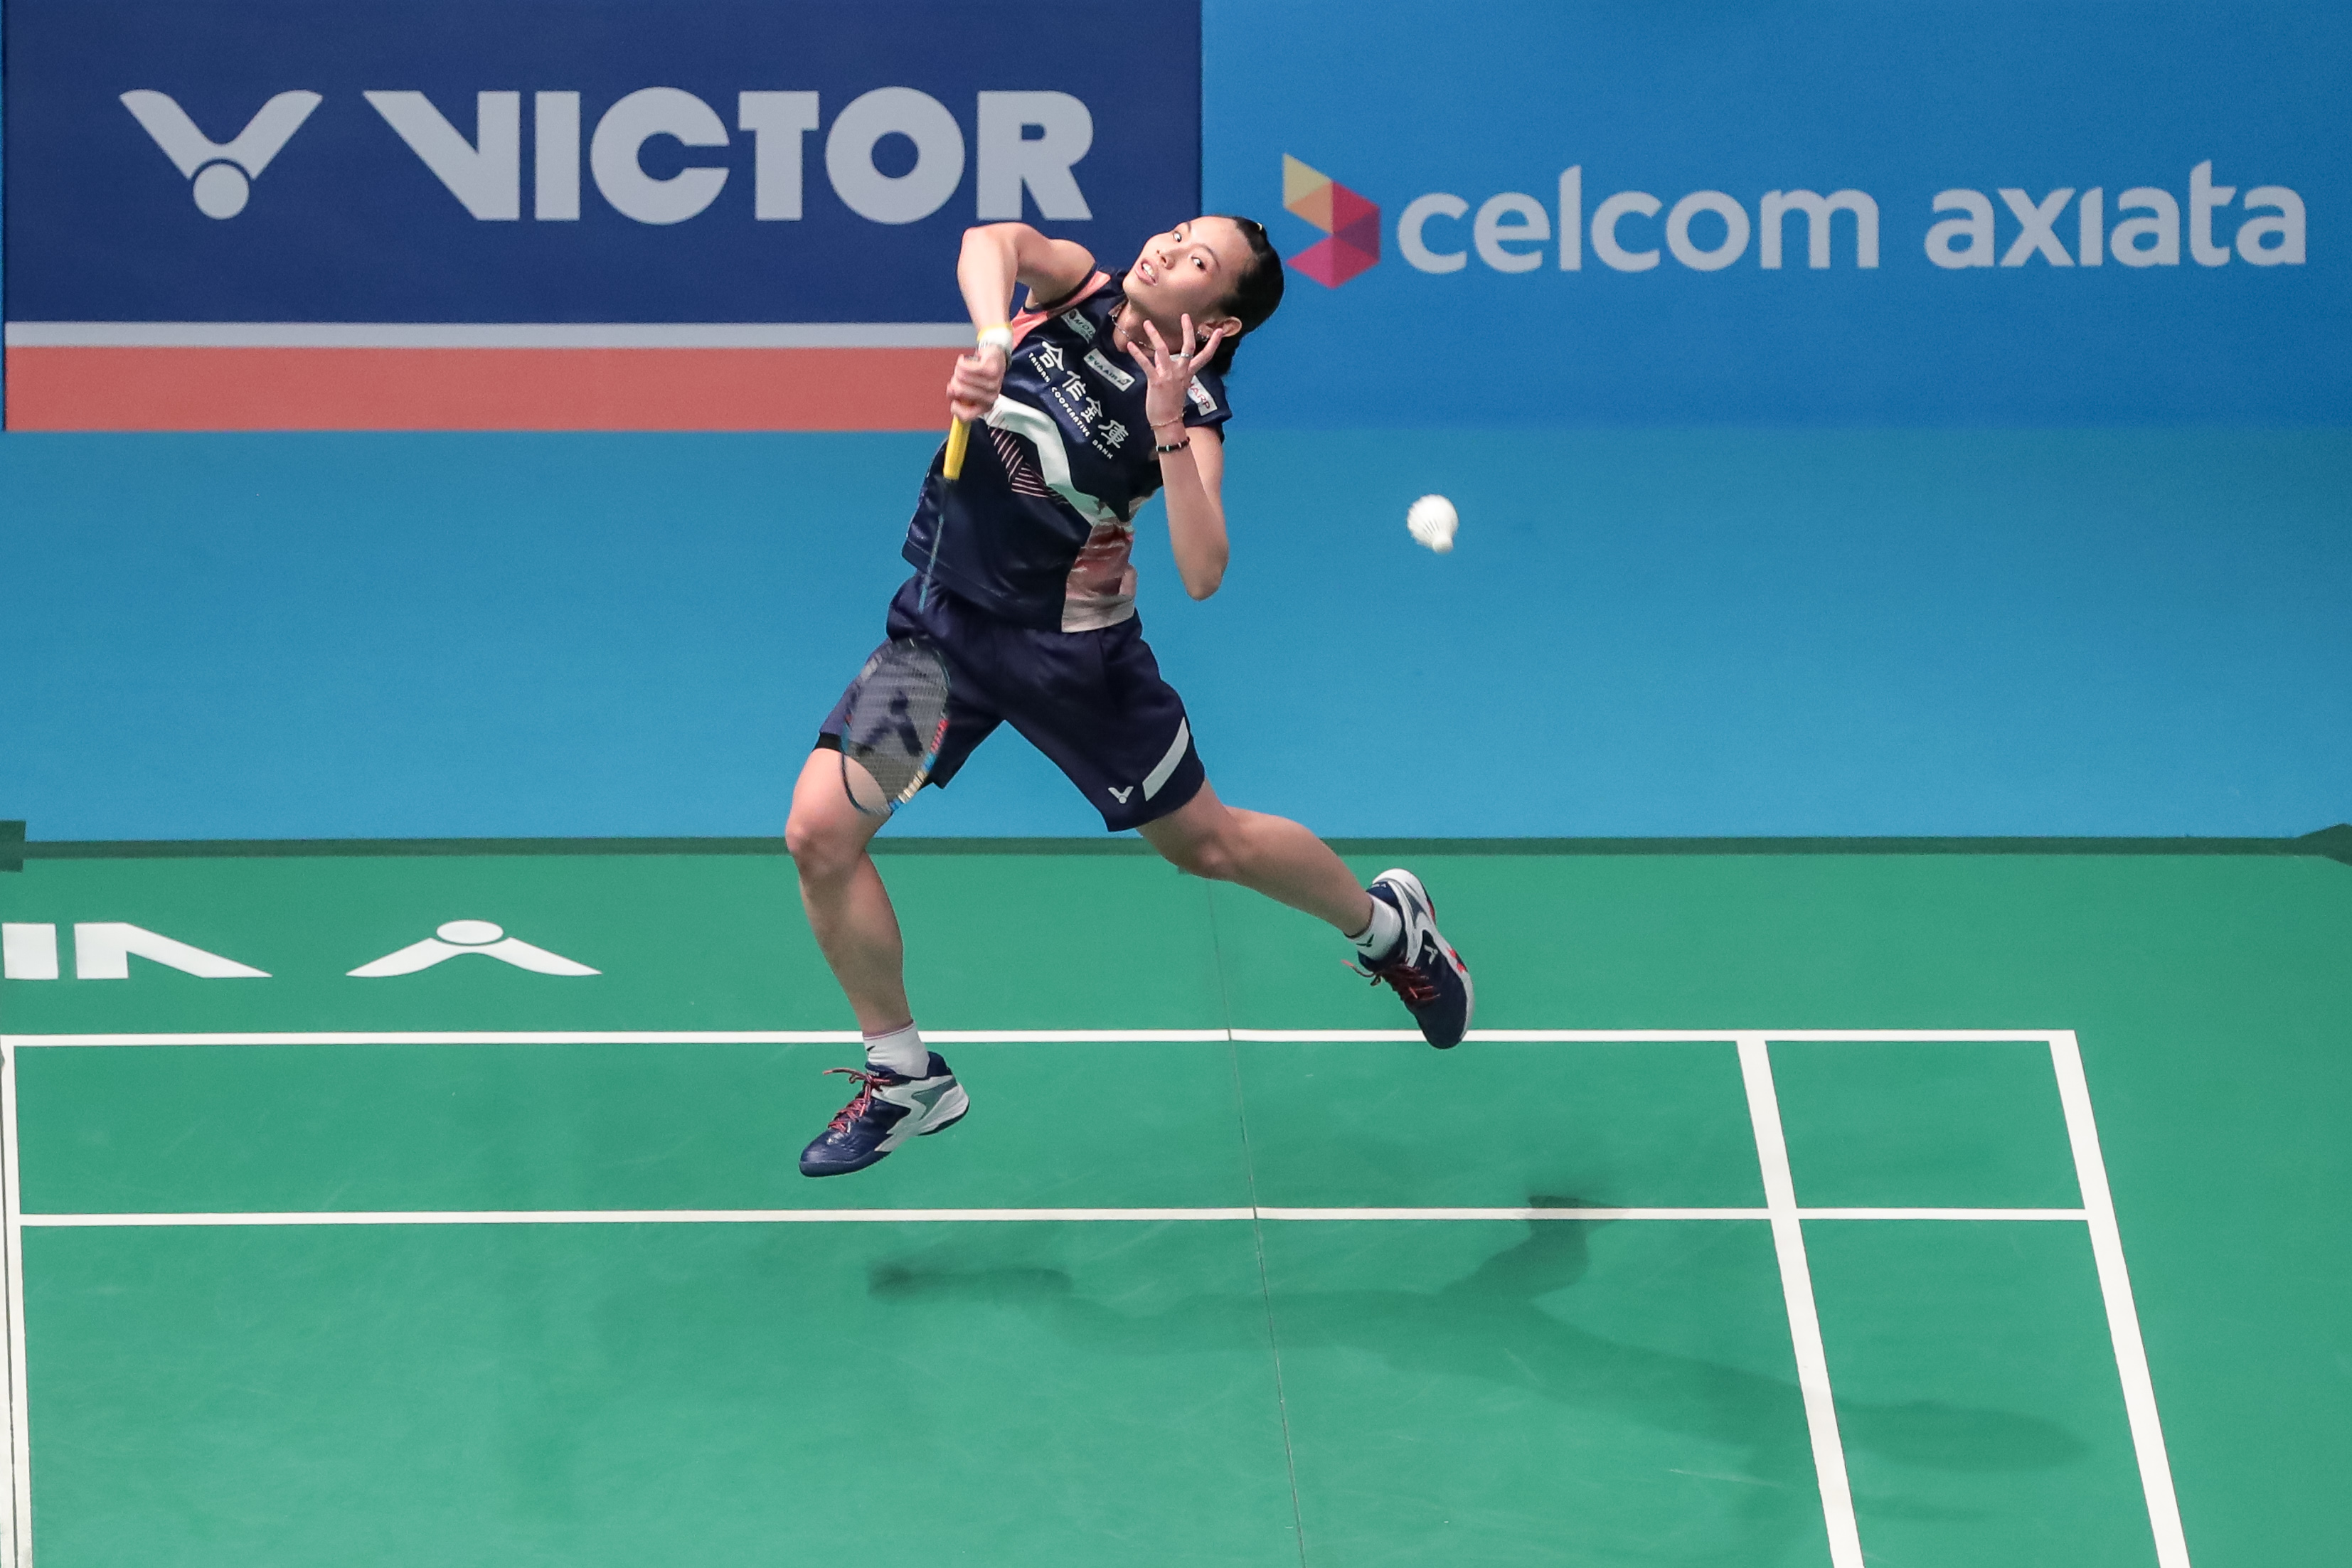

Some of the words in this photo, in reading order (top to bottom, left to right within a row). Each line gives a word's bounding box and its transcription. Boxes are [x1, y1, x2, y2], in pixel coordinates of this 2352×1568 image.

[363, 86, 1093, 225] VICTOR
[1397, 165, 1880, 274] celcom
[1924, 160, 2306, 270] axiata
[1028, 352, 1051, 383] TAIWAN
[1051, 386, 1091, 437] COOPERATIVE
[1092, 439, 1114, 459] BANK
[1039, 341, 1129, 449] 合作金庫
